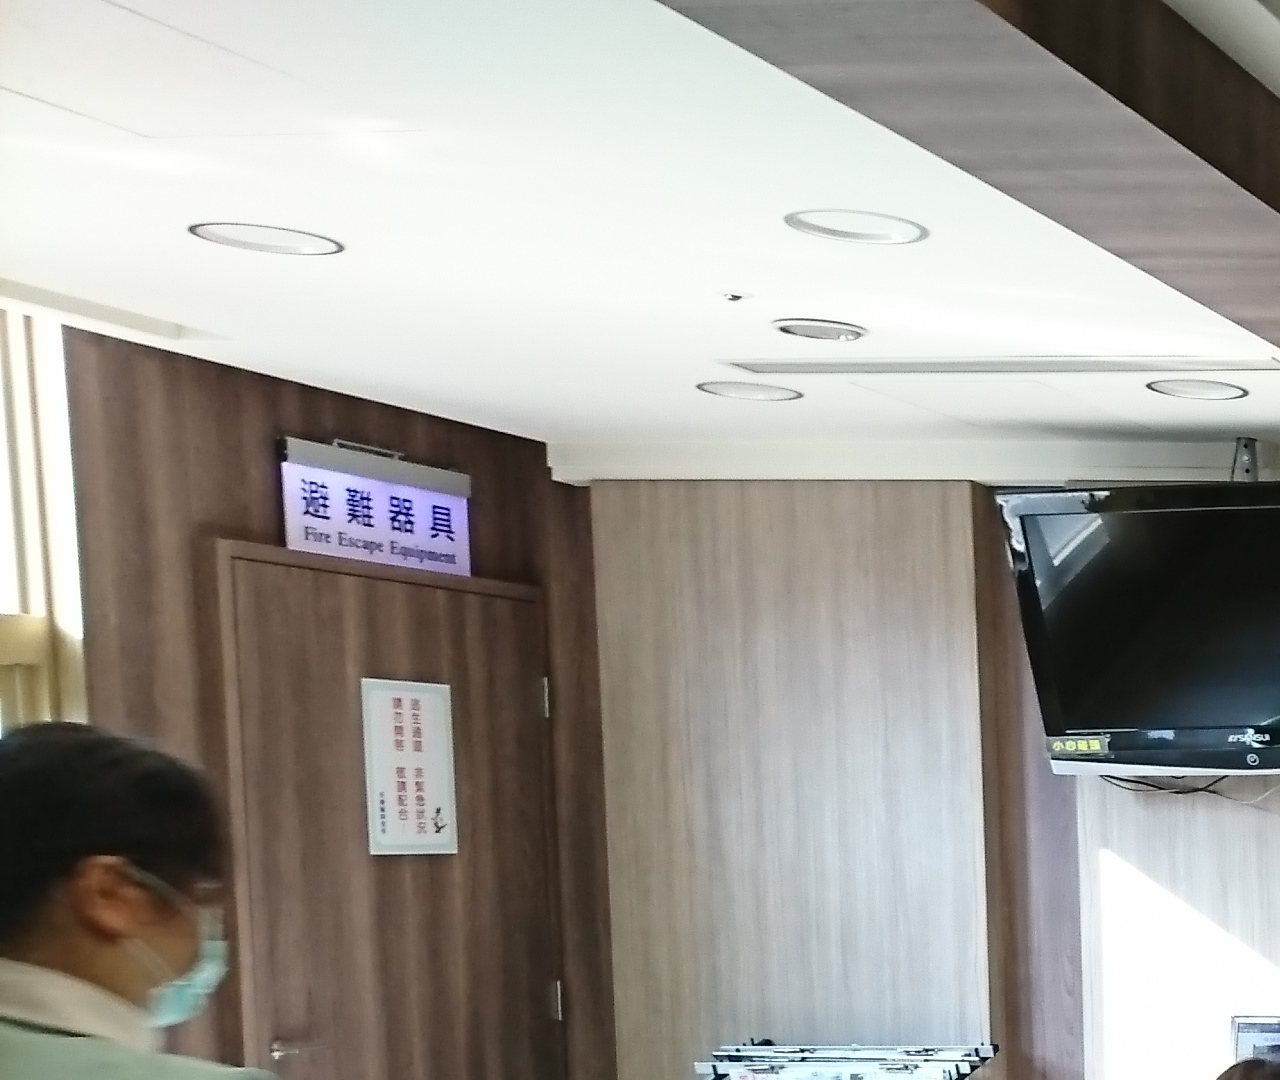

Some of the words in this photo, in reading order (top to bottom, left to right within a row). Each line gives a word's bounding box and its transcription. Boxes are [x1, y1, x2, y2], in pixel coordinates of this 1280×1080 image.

[301, 478, 455, 542] 避難器具
[304, 526, 331, 544] Fire
[338, 531, 384, 555] Escape
